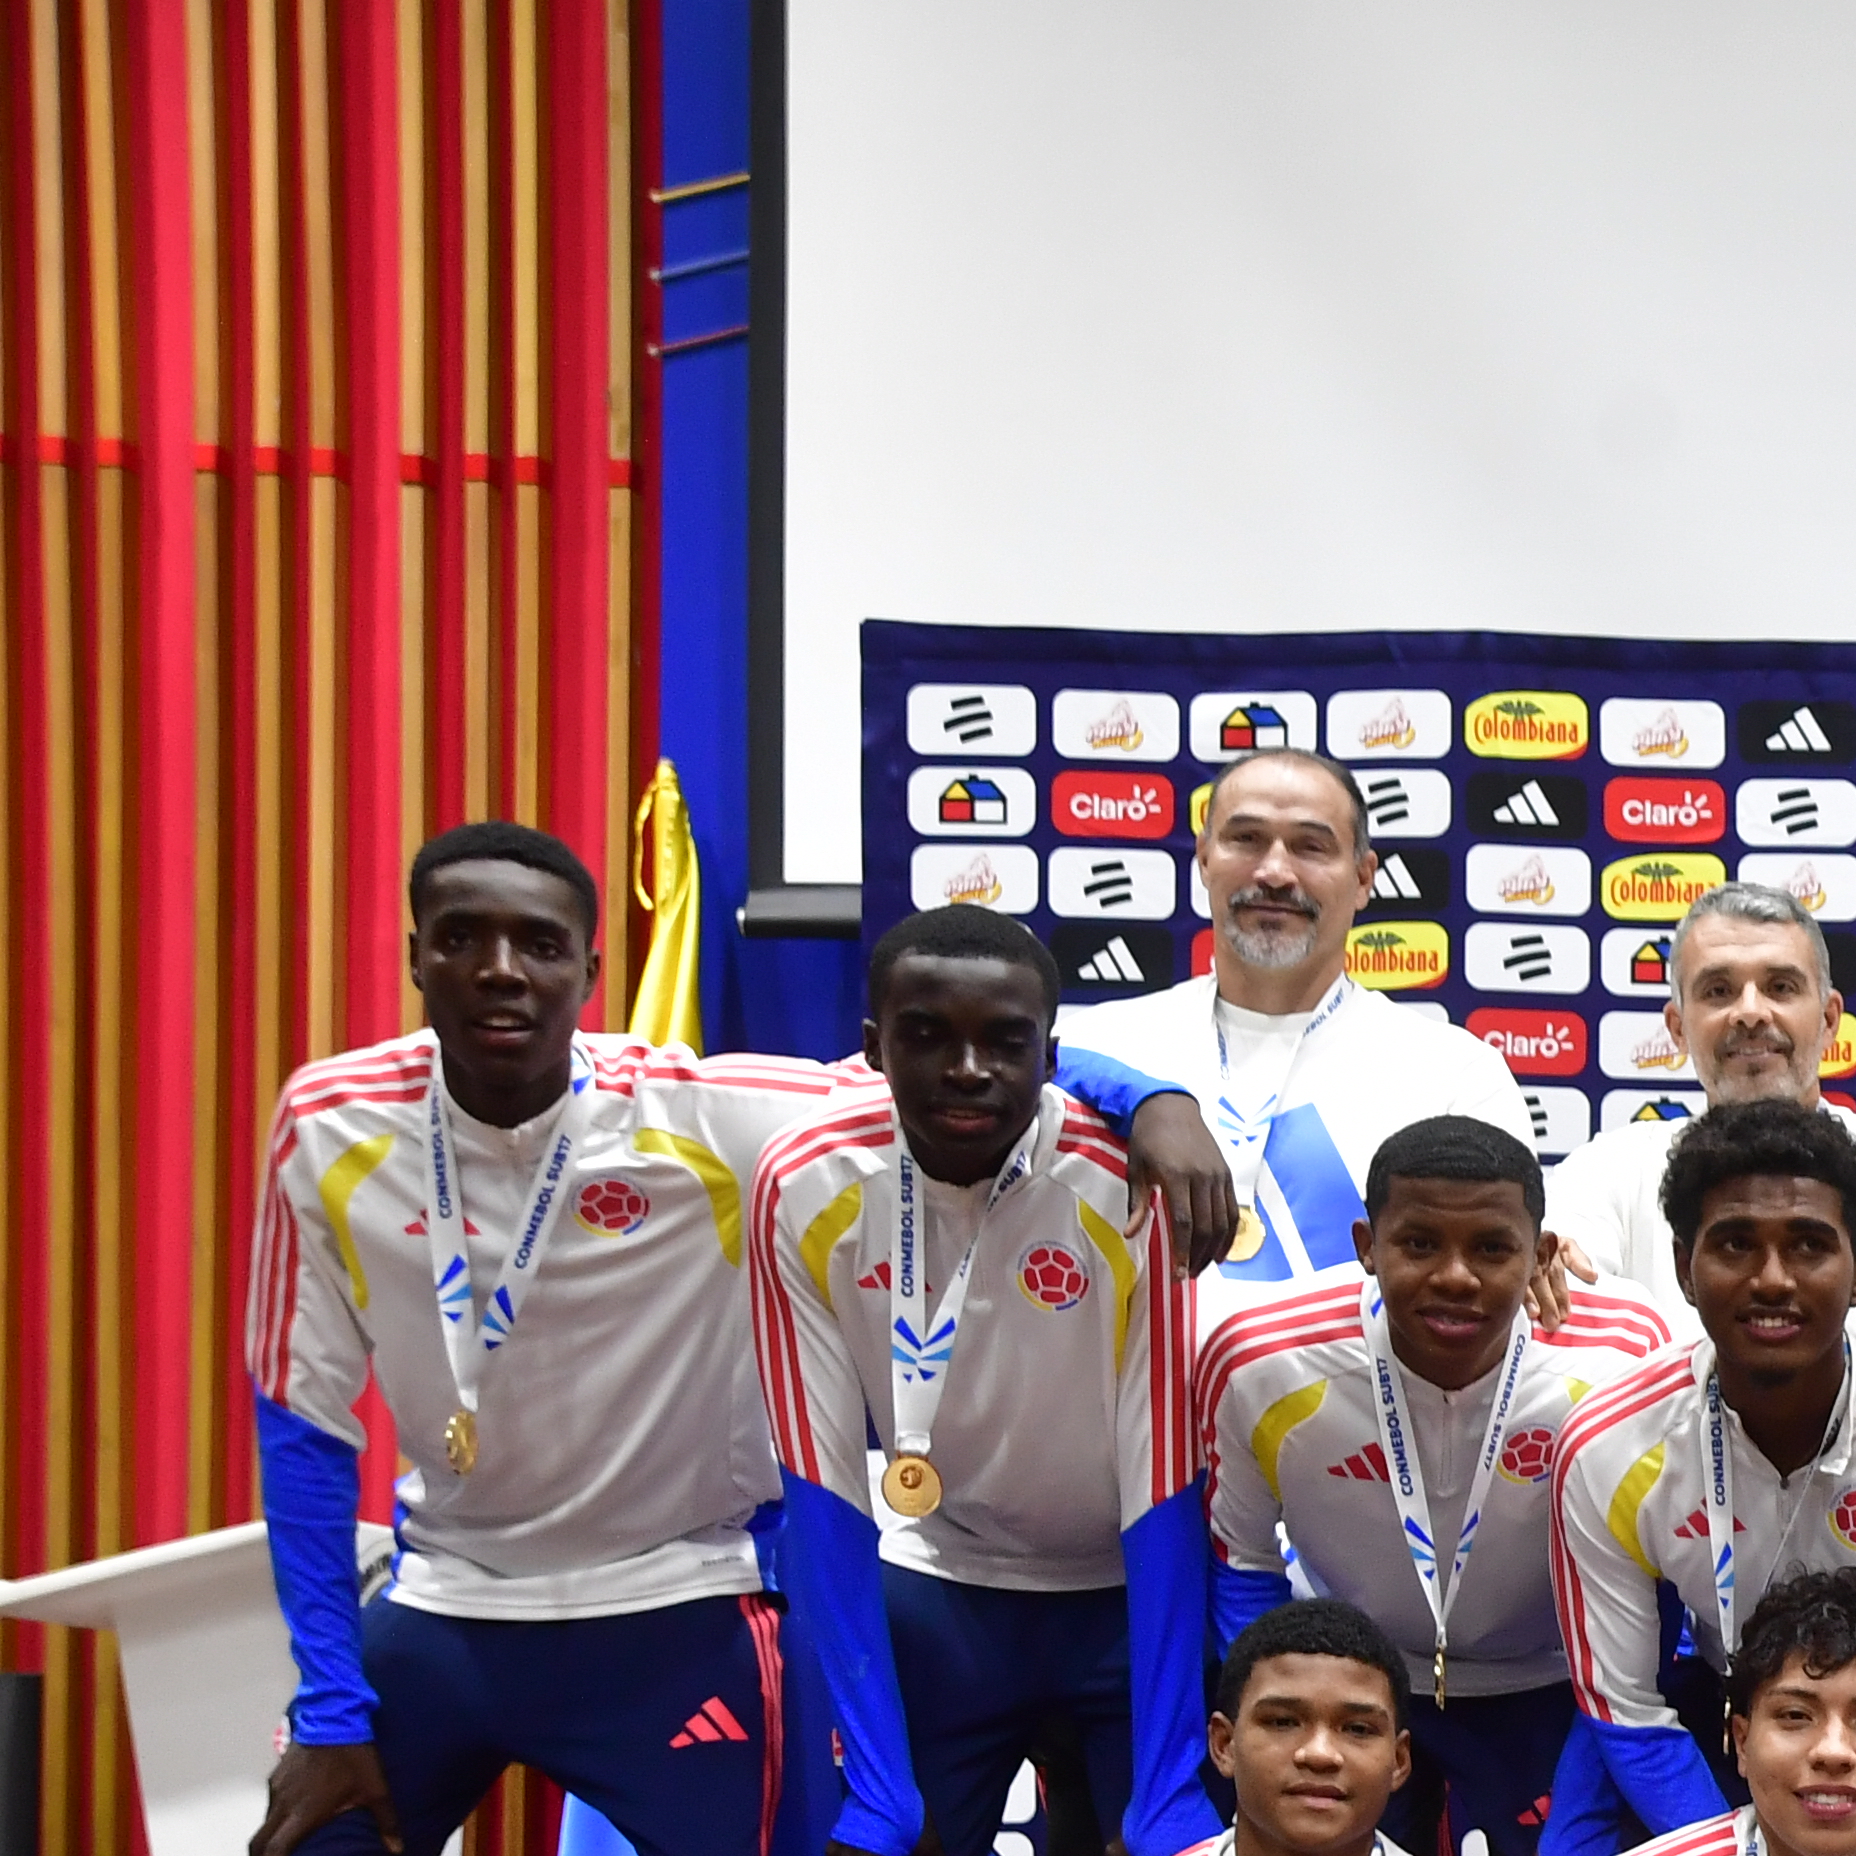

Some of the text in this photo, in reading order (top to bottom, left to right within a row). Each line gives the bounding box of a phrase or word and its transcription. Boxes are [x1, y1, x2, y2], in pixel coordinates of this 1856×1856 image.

[1473, 714, 1579, 746] Colombiana
[1070, 792, 1147, 821] Claro
[1622, 798, 1698, 827] Claro
[1344, 942, 1438, 974] olombiana
[436, 1128, 454, 1219] CONMEBOL
[515, 1134, 574, 1269] CONMEBOL SUB17
[900, 1155, 916, 1298] CONMEBOL SUB17
[1377, 1357, 1413, 1496] CONMEBOL SUB17
[1483, 1334, 1527, 1471] CONMEBOL SUB17
[1711, 1417, 1727, 1506] CONMEBOL
